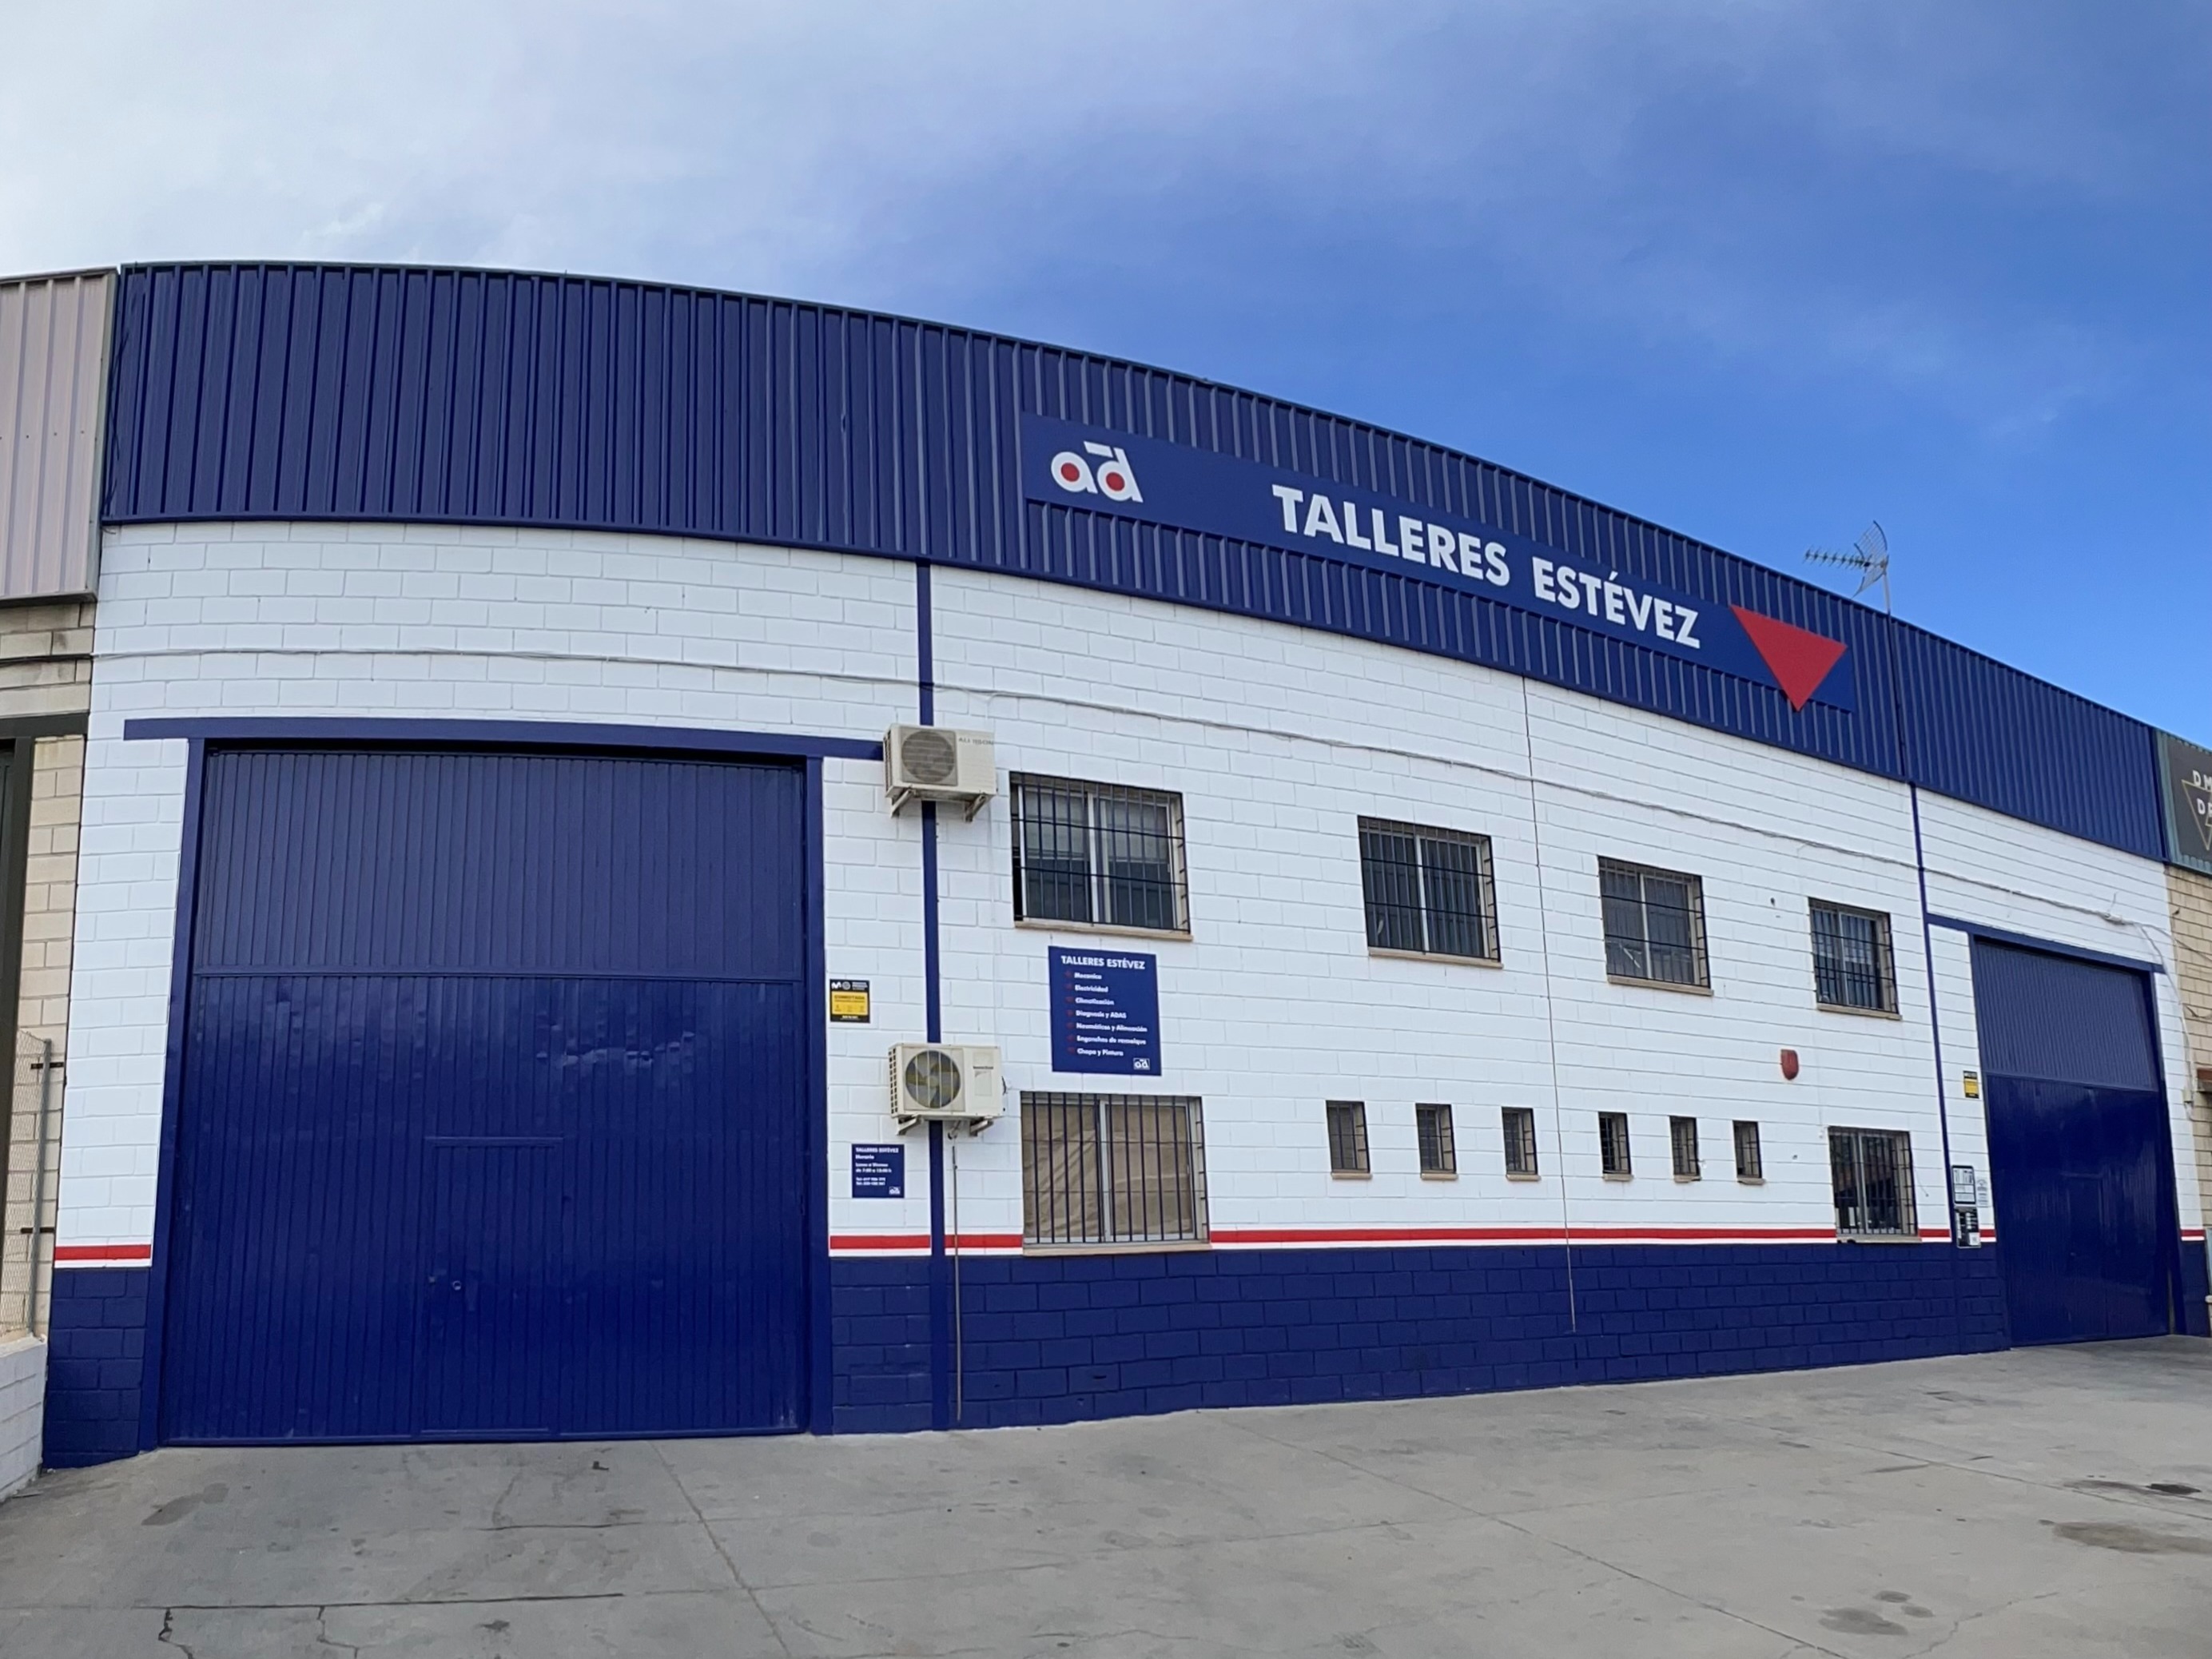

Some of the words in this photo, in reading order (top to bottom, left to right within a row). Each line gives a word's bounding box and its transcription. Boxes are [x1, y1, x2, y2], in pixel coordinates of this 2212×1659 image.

[1271, 484, 1510, 587] TALLERES
[1532, 556, 1701, 649] ESTÉVEZ
[1060, 955, 1104, 966] TALLERES
[1107, 957, 1145, 969] ESTÉVEZ
